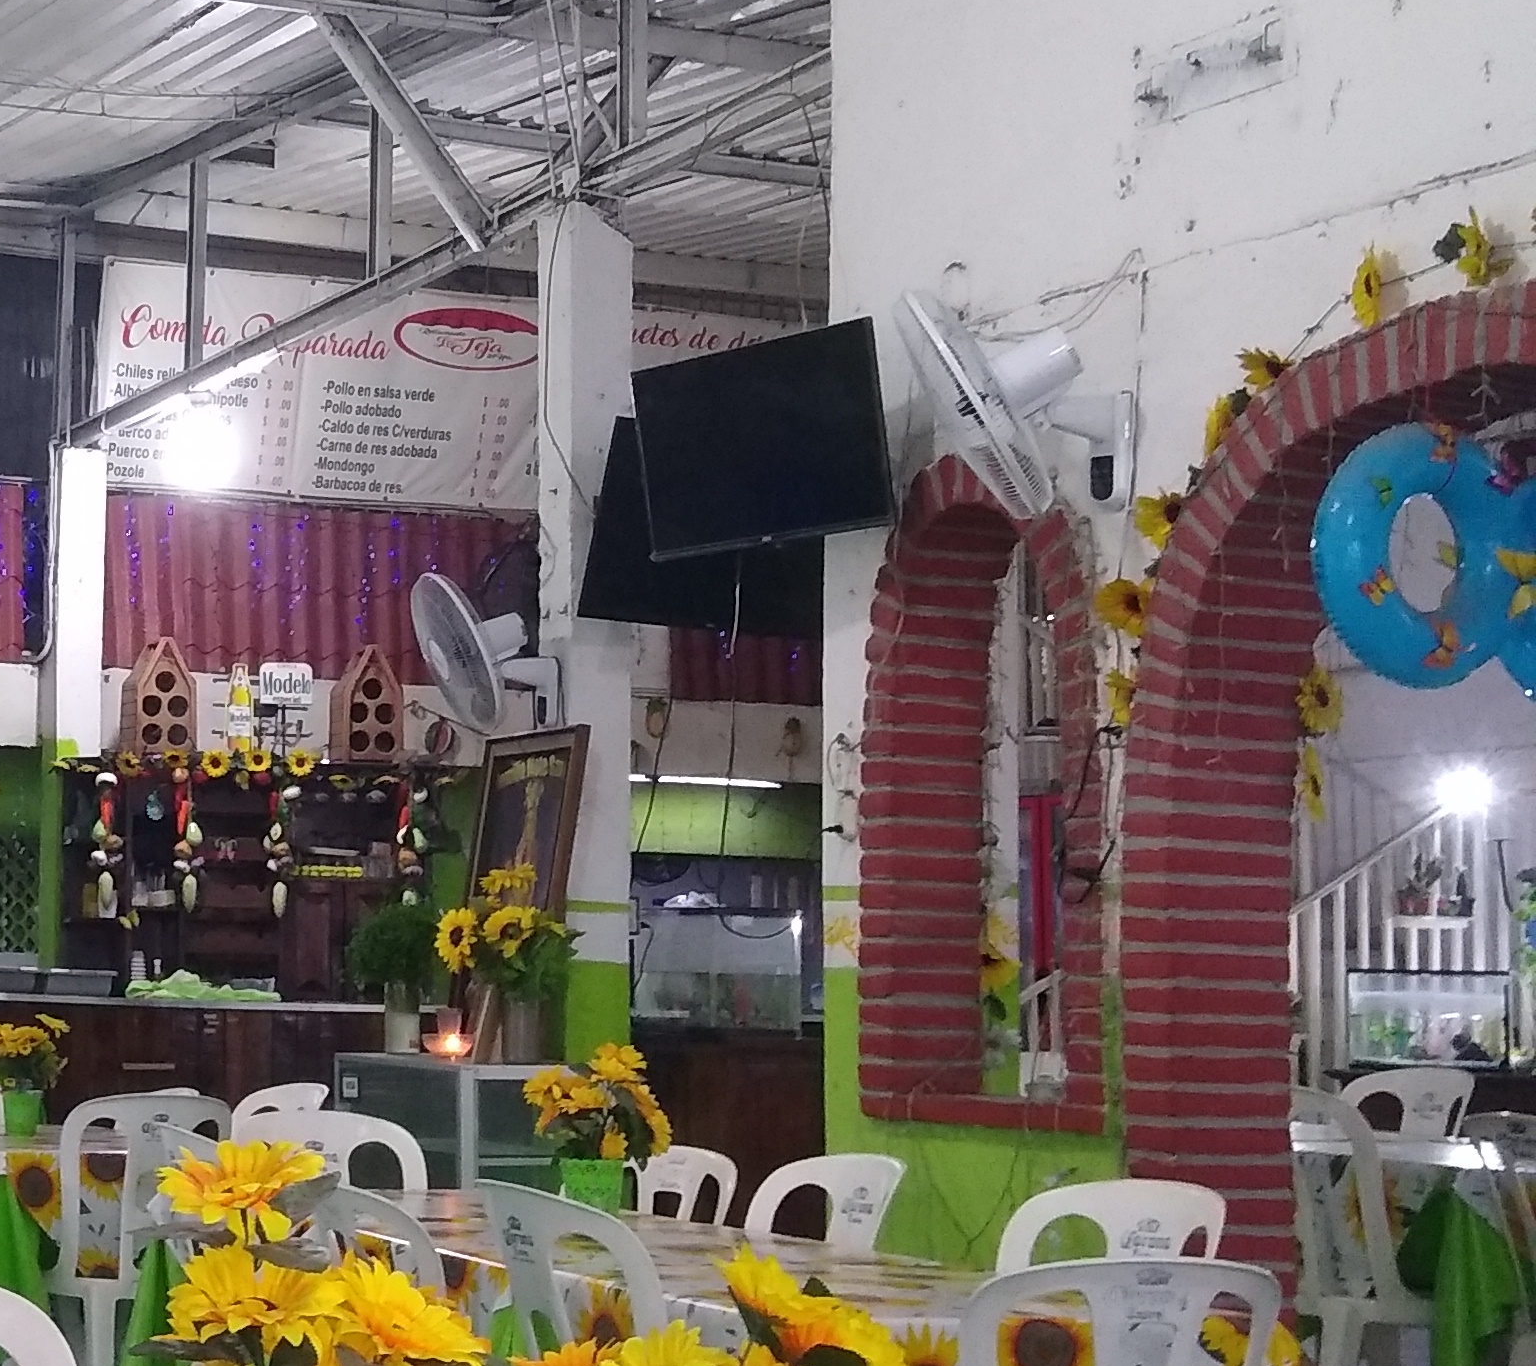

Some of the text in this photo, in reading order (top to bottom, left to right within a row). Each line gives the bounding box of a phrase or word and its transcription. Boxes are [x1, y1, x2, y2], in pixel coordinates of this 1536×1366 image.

[121, 304, 230, 348] Comda
[688, 328, 721, 350] de
[357, 386, 371, 398] en
[373, 384, 401, 400] salsa
[404, 388, 435, 402] verde
[355, 403, 402, 419] adobado
[118, 427, 152, 440] uerco
[356, 421, 370, 436] de
[372, 424, 389, 437] res
[392, 422, 452, 442] C/verduras
[354, 439, 368, 454] de
[370, 443, 387, 456] res
[389, 443, 438, 459] adobada
[368, 478, 382, 493] de
[262, 671, 312, 696] Modelo
